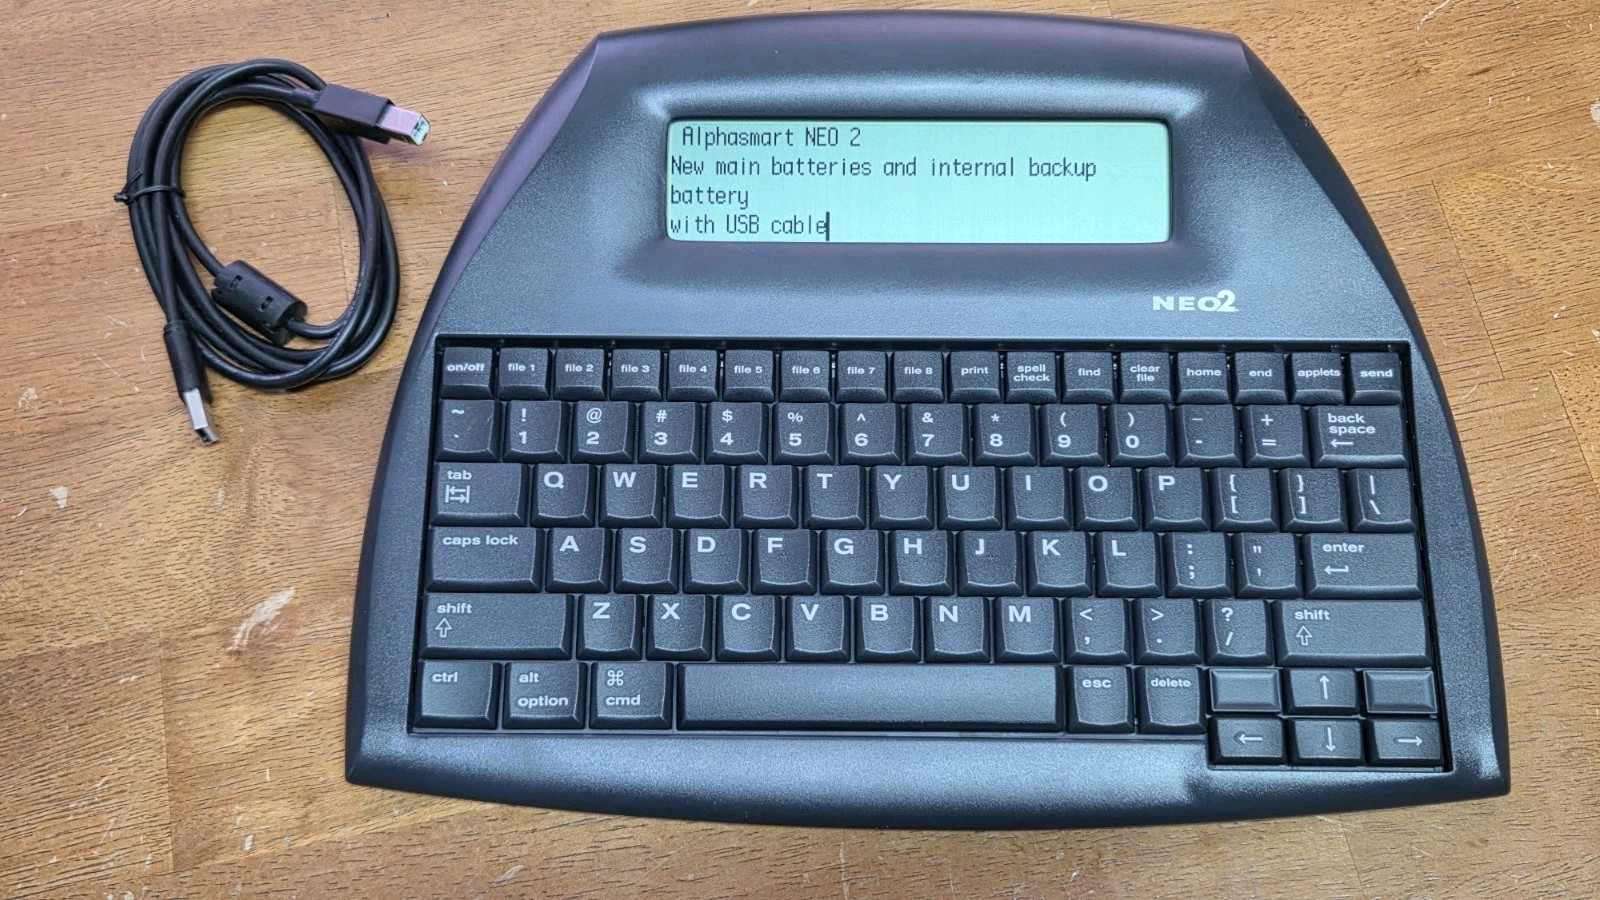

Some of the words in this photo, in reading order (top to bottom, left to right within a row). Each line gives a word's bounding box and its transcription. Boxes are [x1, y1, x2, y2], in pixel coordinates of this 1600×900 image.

[682, 126, 794, 151] Alphasmart
[805, 126, 839, 147] NEO
[849, 126, 861, 147] 2
[671, 155, 704, 176] New
[715, 157, 760, 176] main
[771, 156, 872, 176] batteries
[883, 157, 917, 177] and
[931, 156, 1014, 177] internal
[1028, 156, 1097, 182] backup
[671, 184, 749, 210] battery
[671, 213, 715, 234] with
[726, 214, 760, 235] USB
[771, 214, 829, 235] cable
[446, 362, 486, 372] on/off
[507, 362, 527, 372] file
[564, 363, 583, 373] file
[620, 364, 639, 373] file
[678, 364, 697, 373] file
[733, 365, 752, 374] file
[791, 365, 810, 375] file
[846, 366, 865, 375] file
[903, 366, 923, 375] file
[960, 365, 989, 376] print
[1017, 363, 1046, 374] spell
[1077, 367, 1101, 377] find
[1129, 363, 1161, 373] clear
[1186, 367, 1222, 377] home
[1248, 368, 1273, 377] end
[1297, 367, 1341, 379] applets
[1359, 368, 1393, 378] send
[1013, 373, 1050, 382] check
[1136, 373, 1155, 382] file
[521, 407, 527, 422] !
[586, 407, 603, 424] @
[655, 409, 668, 423] #
[721, 408, 734, 423] $
[921, 411, 934, 423] &
[1059, 411, 1067, 427] (
[1127, 412, 1135, 428] )
[1260, 414, 1274, 426] +
[1327, 412, 1366, 424] back
[518, 430, 527, 445] 1
[586, 431, 600, 445] 2
[1329, 425, 1376, 436] space
[653, 431, 668, 446] 3
[719, 432, 734, 446] 4
[788, 432, 802, 447] 5
[854, 432, 869, 447] 6
[921, 433, 935, 447] 7
[989, 433, 1004, 448] 8
[1057, 434, 1072, 449] 9
[1125, 434, 1140, 449] 0
[446, 469, 473, 481] tab
[543, 471, 565, 489] Q
[612, 471, 637, 488] W
[681, 471, 699, 489] E
[749, 472, 768, 489] R
[816, 472, 833, 490] T
[882, 473, 902, 490] Y
[951, 474, 970, 491] U
[1025, 474, 1032, 491] I
[1087, 475, 1109, 493] O
[1158, 475, 1176, 492] P
[442, 536, 480, 549] caps
[485, 534, 519, 546] lock
[559, 535, 580, 552] A
[628, 536, 647, 554] S
[697, 536, 716, 553] D
[767, 537, 784, 554] F
[833, 537, 854, 555] G
[903, 537, 923, 555] H
[974, 538, 985, 556] J
[1042, 538, 1061, 556] K
[1111, 539, 1127, 557] L
[1322, 542, 1365, 553] enter
[436, 602, 473, 614] shift
[592, 601, 611, 619] Z
[660, 602, 681, 620] X
[731, 602, 752, 621] C
[800, 603, 820, 621] V
[870, 604, 889, 622] B
[939, 604, 959, 623] N
[1008, 605, 1032, 623] M
[1079, 608, 1093, 621] <
[1150, 608, 1165, 621] >
[1221, 607, 1234, 622] ?
[1294, 609, 1330, 621] shift
[432, 671, 458, 683] ctrl
[518, 671, 539, 683] alt
[1082, 679, 1112, 689] esc
[1150, 677, 1191, 688] delete
[517, 695, 569, 709] option
[605, 694, 641, 706] cmd
